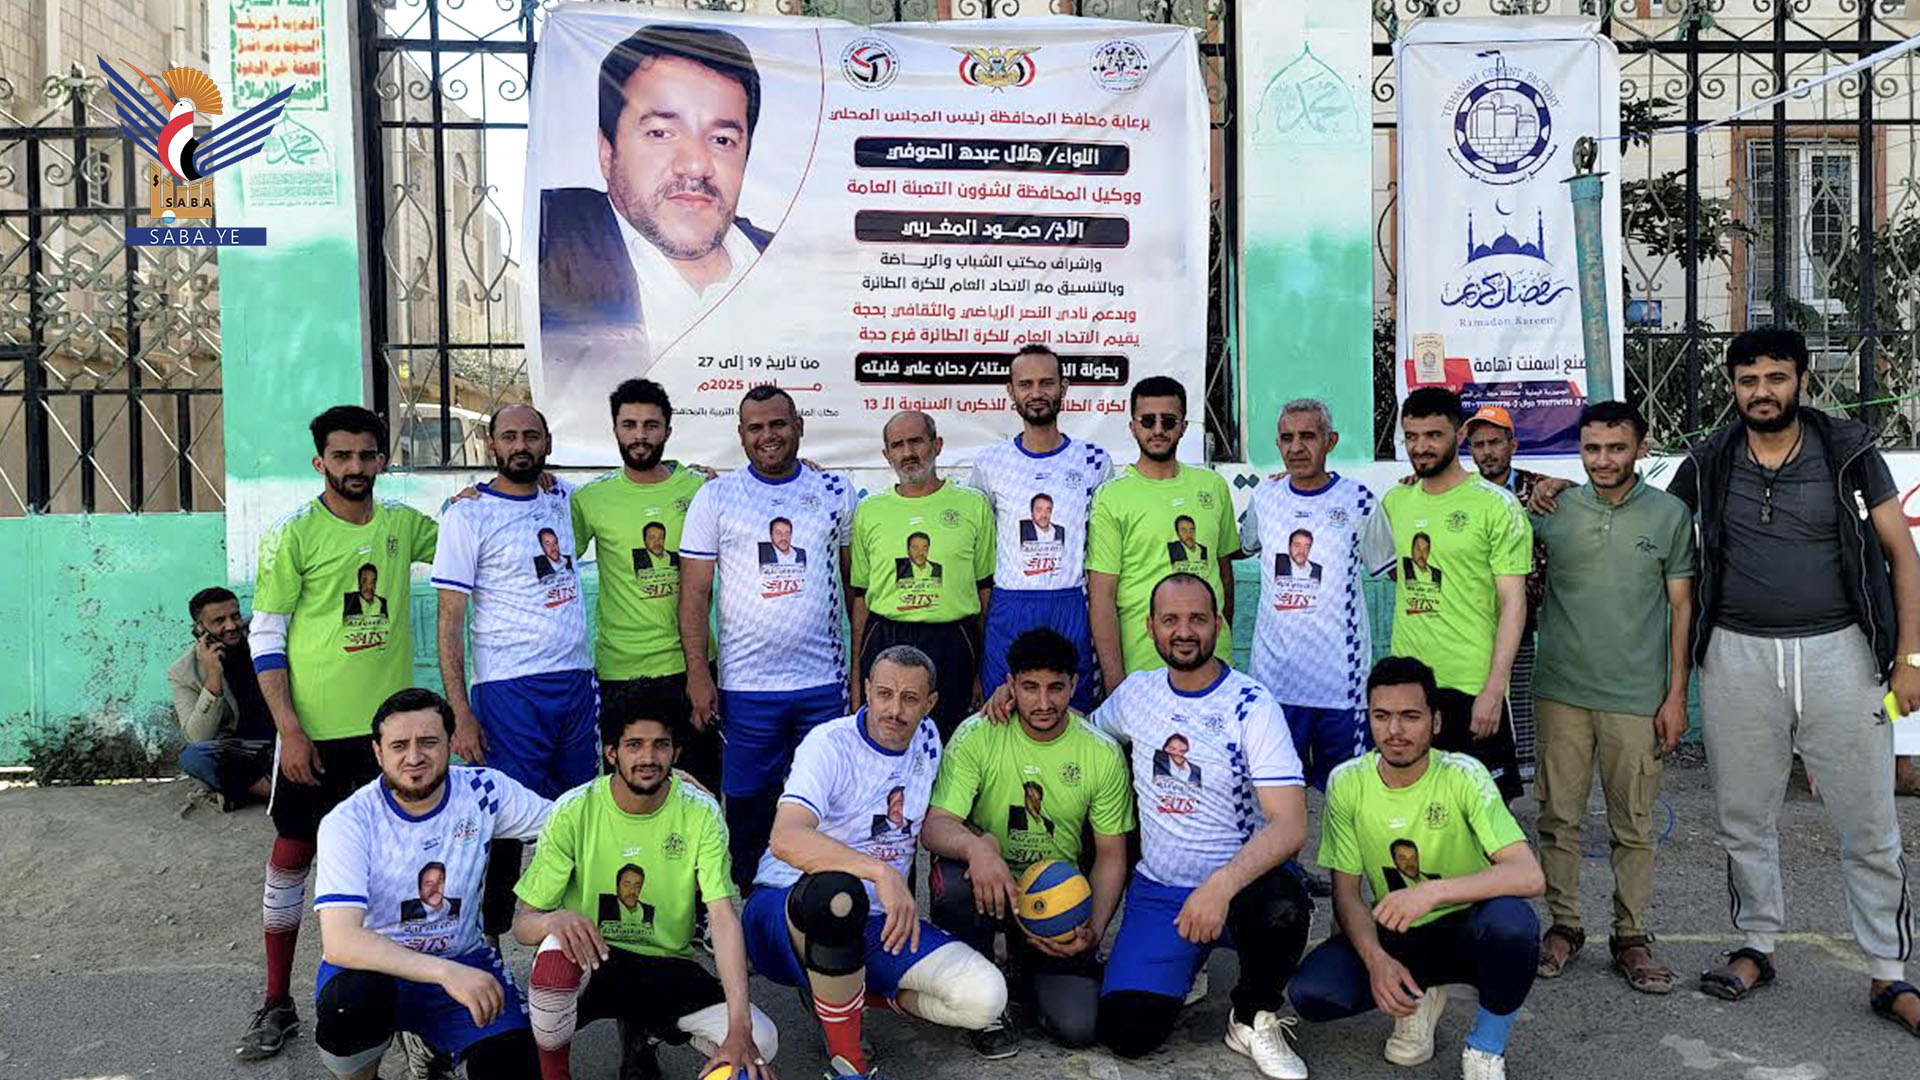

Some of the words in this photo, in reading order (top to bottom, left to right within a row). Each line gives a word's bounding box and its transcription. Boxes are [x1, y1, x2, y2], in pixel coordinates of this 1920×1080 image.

[829, 106, 880, 122] المحلي
[885, 109, 942, 125] المجلس
[947, 111, 985, 126] رئيس
[989, 111, 1056, 127] المحافظة
[1061, 111, 1108, 128] محافظ
[1112, 113, 1150, 129] برعاية
[886, 141, 952, 162] الصوفي
[1004, 144, 1041, 163] هلال
[847, 179, 896, 195] العامة
[902, 182, 951, 199] التعبئة
[957, 183, 1011, 201] لشؤون
[1016, 184, 1086, 201] المحافظة
[1092, 187, 1141, 204] ووكيل
[982, 219, 1041, 238] حمود
[956, 255, 1002, 269] الشباب
[1007, 256, 1046, 270] مكتب
[862, 276, 906, 290] الطائرة
[911, 278, 945, 291] للكرة
[950, 279, 985, 293] العام
[1034, 284, 1053, 295] مع
[1057, 281, 1124, 297] وبالتنسيق
[853, 303, 887, 318] بحجة
[1018, 306, 1051, 321] النصر
[1092, 308, 1137, 323] وبدعم
[1459, 318, 1511, 327] Ramadan
[1515, 316, 1557, 325] Kareem
[859, 327, 887, 341] حجة
[890, 327, 916, 343] فرع
[920, 328, 968, 343] الطائرة
[973, 329, 1009, 343] للكرة
[1013, 329, 1051, 345] العام
[1103, 333, 1140, 347] يقيم
[698, 356, 714, 367] 27
[718, 355, 744, 371] إلى
[748, 357, 762, 368] 19
[766, 356, 796, 370] تاريخ
[800, 359, 820, 370] من
[1474, 356, 1511, 373] تهامة
[1080, 363, 1120, 379] بطولة
[697, 379, 744, 392] 2025م
[863, 398, 877, 410] 13
[899, 397, 952, 412] السنوية
